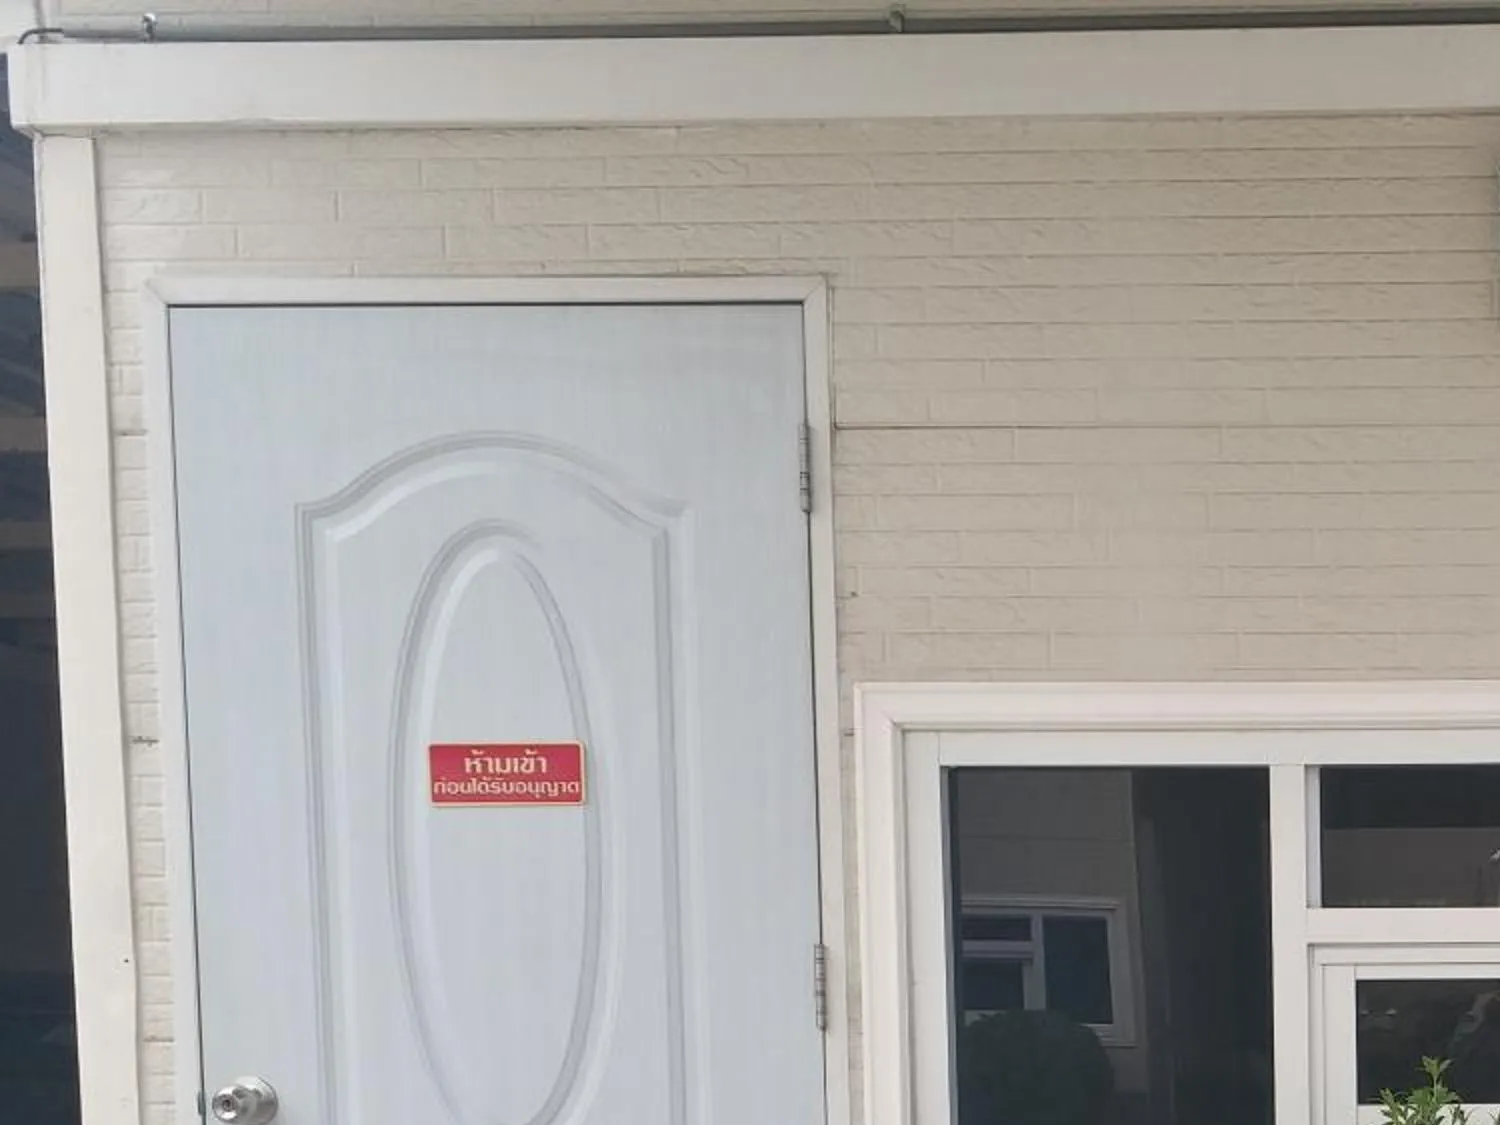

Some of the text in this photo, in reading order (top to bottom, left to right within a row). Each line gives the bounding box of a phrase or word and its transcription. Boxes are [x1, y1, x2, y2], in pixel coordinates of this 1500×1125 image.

[464, 749, 548, 774] ห้ามเข้า
[433, 777, 580, 798] ก่อนได้รับอนุญาต
